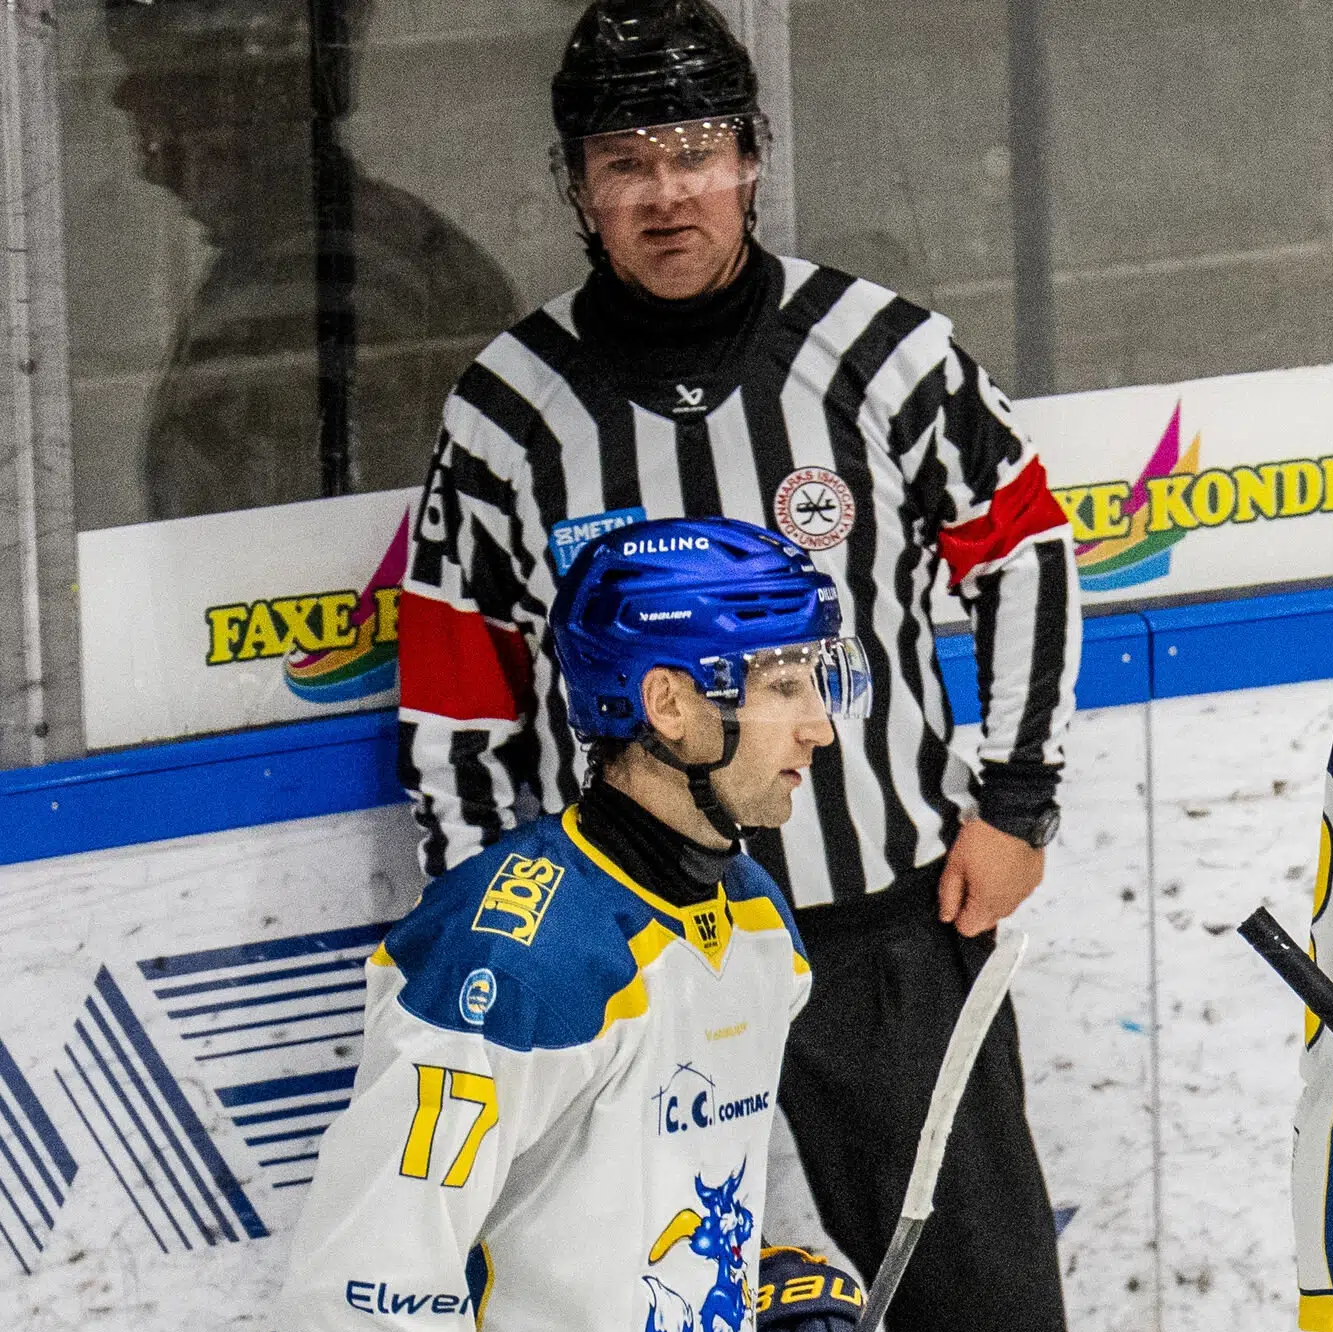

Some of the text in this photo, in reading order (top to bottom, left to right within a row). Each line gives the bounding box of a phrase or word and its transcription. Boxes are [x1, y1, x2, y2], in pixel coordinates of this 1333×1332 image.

[574, 516, 636, 544] META
[623, 536, 710, 556] DILLING
[207, 588, 359, 667] FAXE
[485, 857, 554, 938] jbs
[399, 1063, 499, 1189] 17
